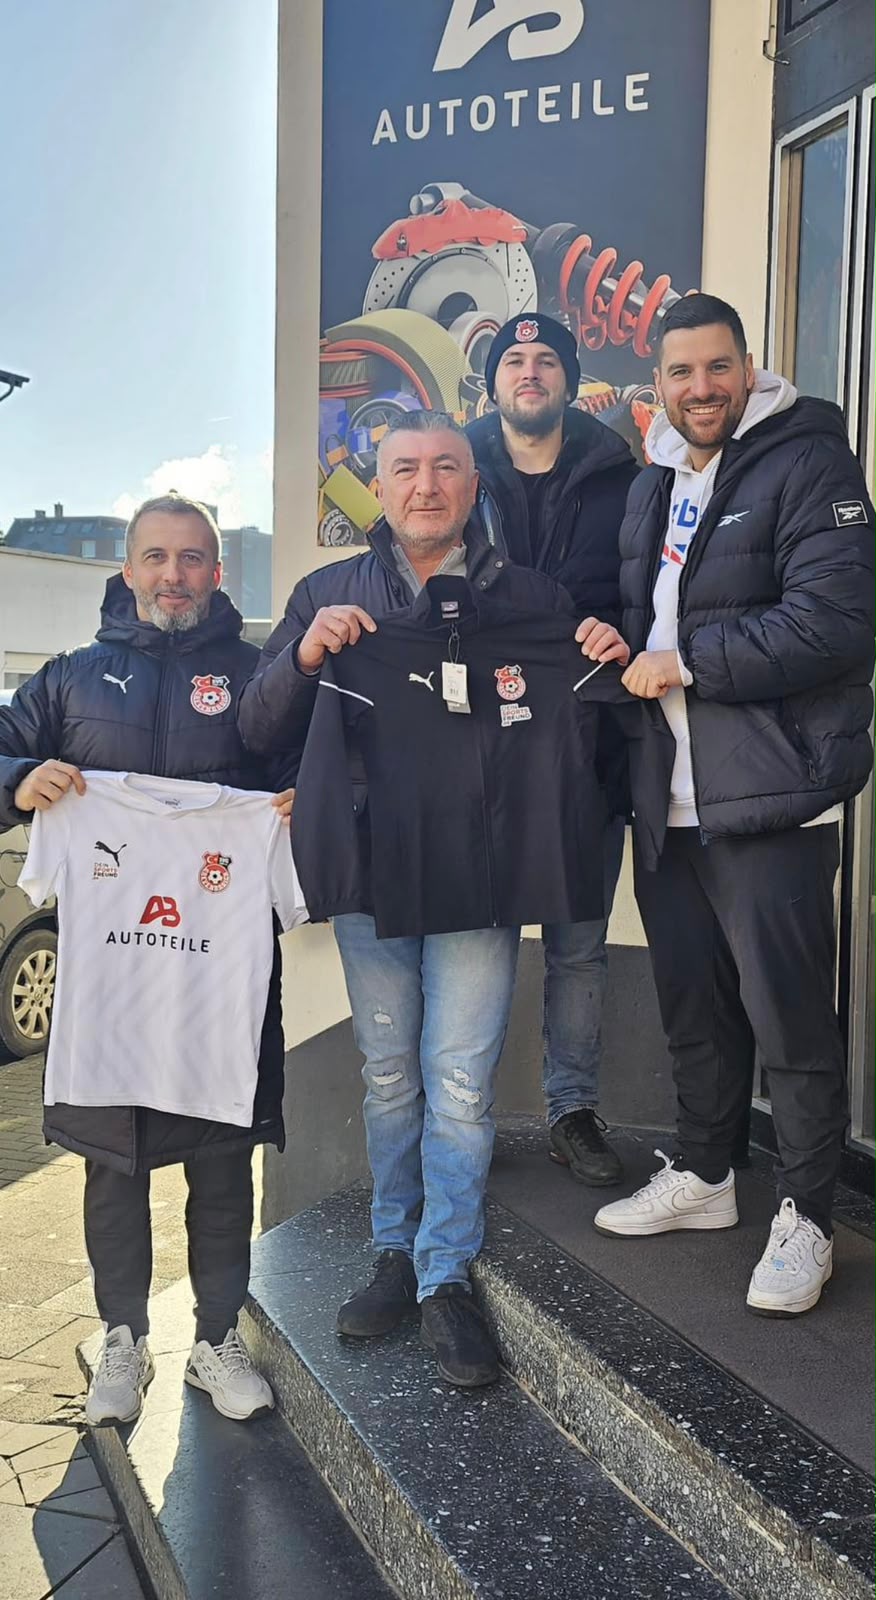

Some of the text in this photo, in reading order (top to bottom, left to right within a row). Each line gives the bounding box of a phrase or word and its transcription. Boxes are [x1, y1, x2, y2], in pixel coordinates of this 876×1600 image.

[371, 72, 650, 146] AUTOTEILE
[139, 895, 181, 928] AB
[106, 930, 211, 953] AUTOTEILE
